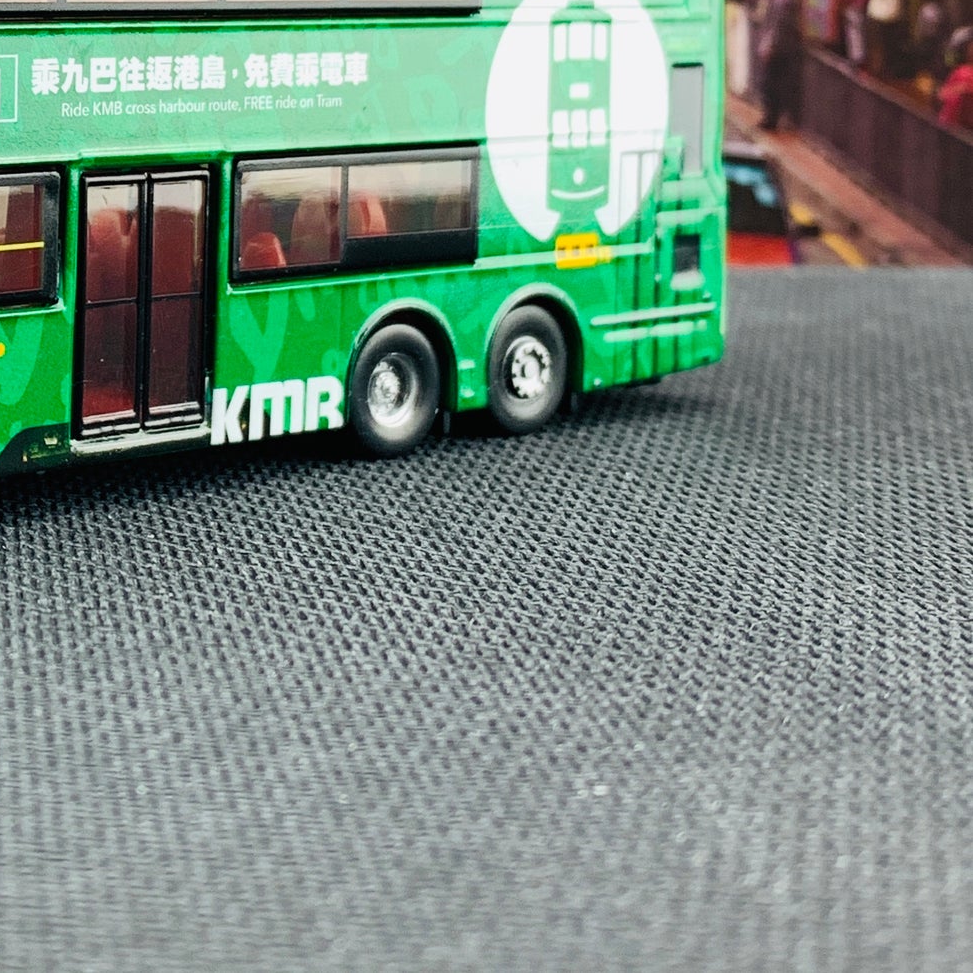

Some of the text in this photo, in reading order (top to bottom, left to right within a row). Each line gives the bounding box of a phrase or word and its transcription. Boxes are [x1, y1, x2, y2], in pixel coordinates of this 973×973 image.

[61, 93, 343, 117] Ride KMB cross harbour route, FREE ride on Tram
